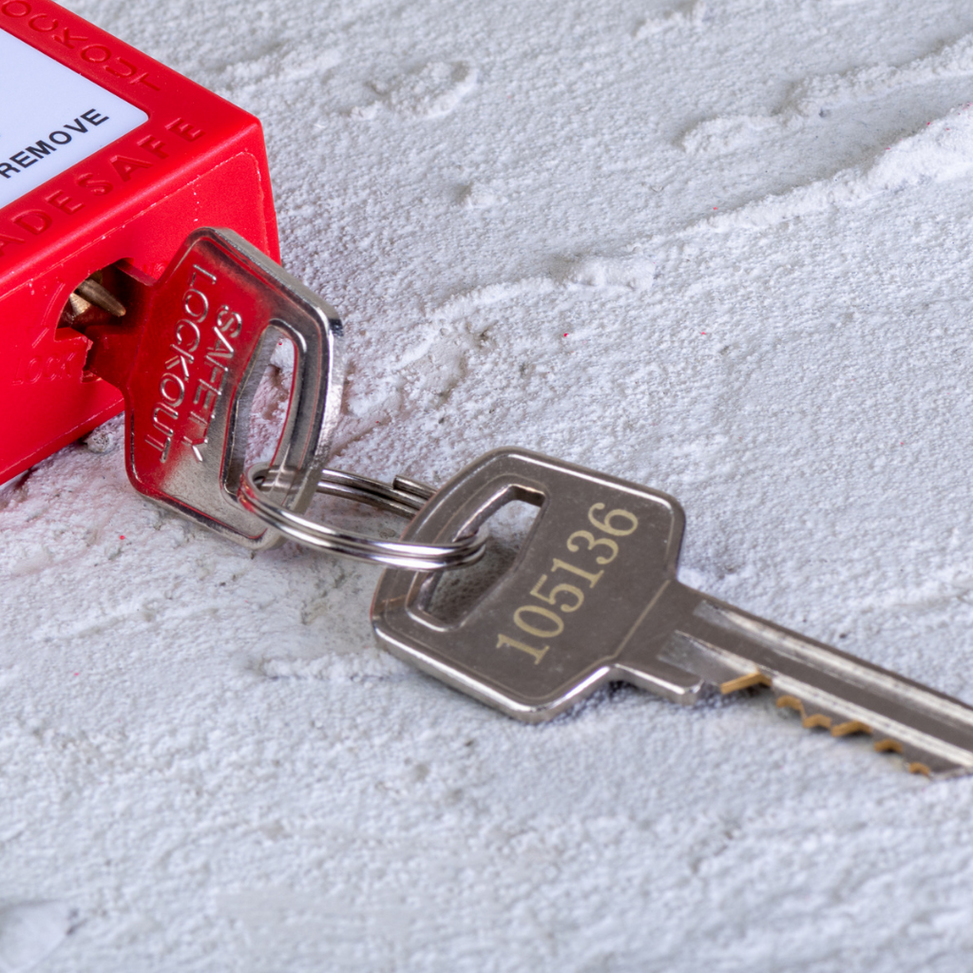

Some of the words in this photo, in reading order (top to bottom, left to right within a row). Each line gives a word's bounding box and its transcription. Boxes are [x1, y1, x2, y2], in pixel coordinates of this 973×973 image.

[11, 351, 77, 386] LOCK
[144, 263, 217, 464] LOCKOUT
[179, 304, 243, 463] SAFETY
[496, 502, 639, 666] 105136
